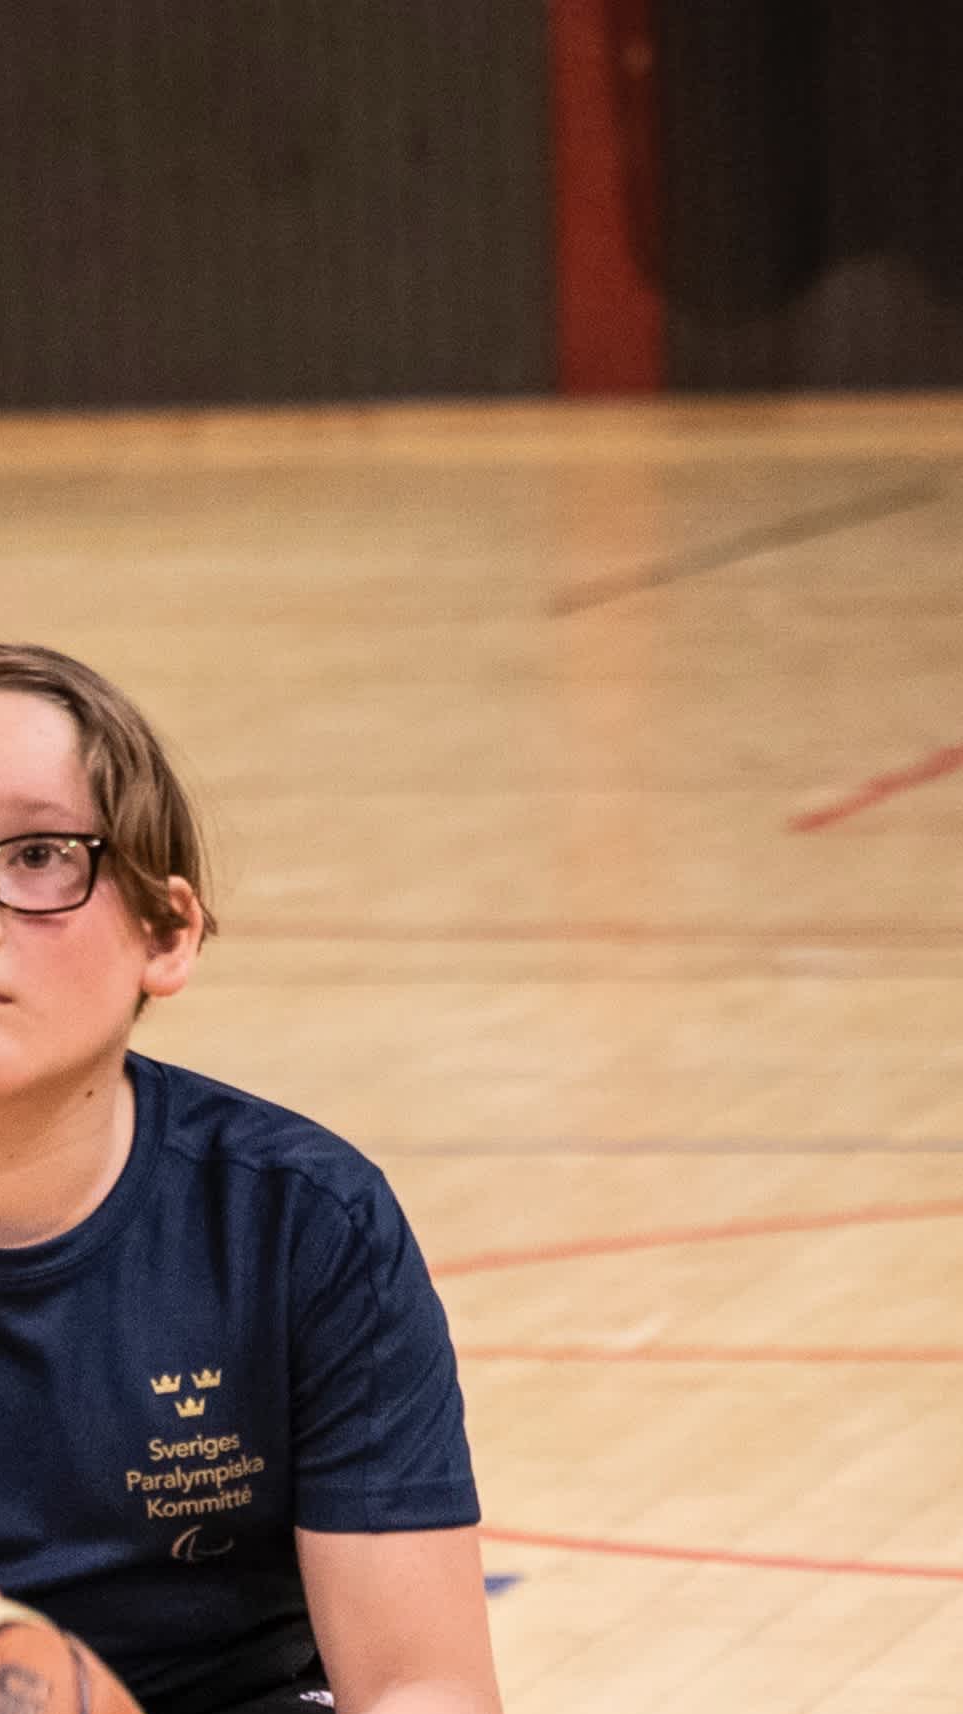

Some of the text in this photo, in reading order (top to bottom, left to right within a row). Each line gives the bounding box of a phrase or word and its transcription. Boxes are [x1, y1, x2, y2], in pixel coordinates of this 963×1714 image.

[148, 1434, 240, 1460] Sveriges
[125, 1455, 265, 1493] Paralympiska
[146, 1484, 253, 1519] Kommitté
